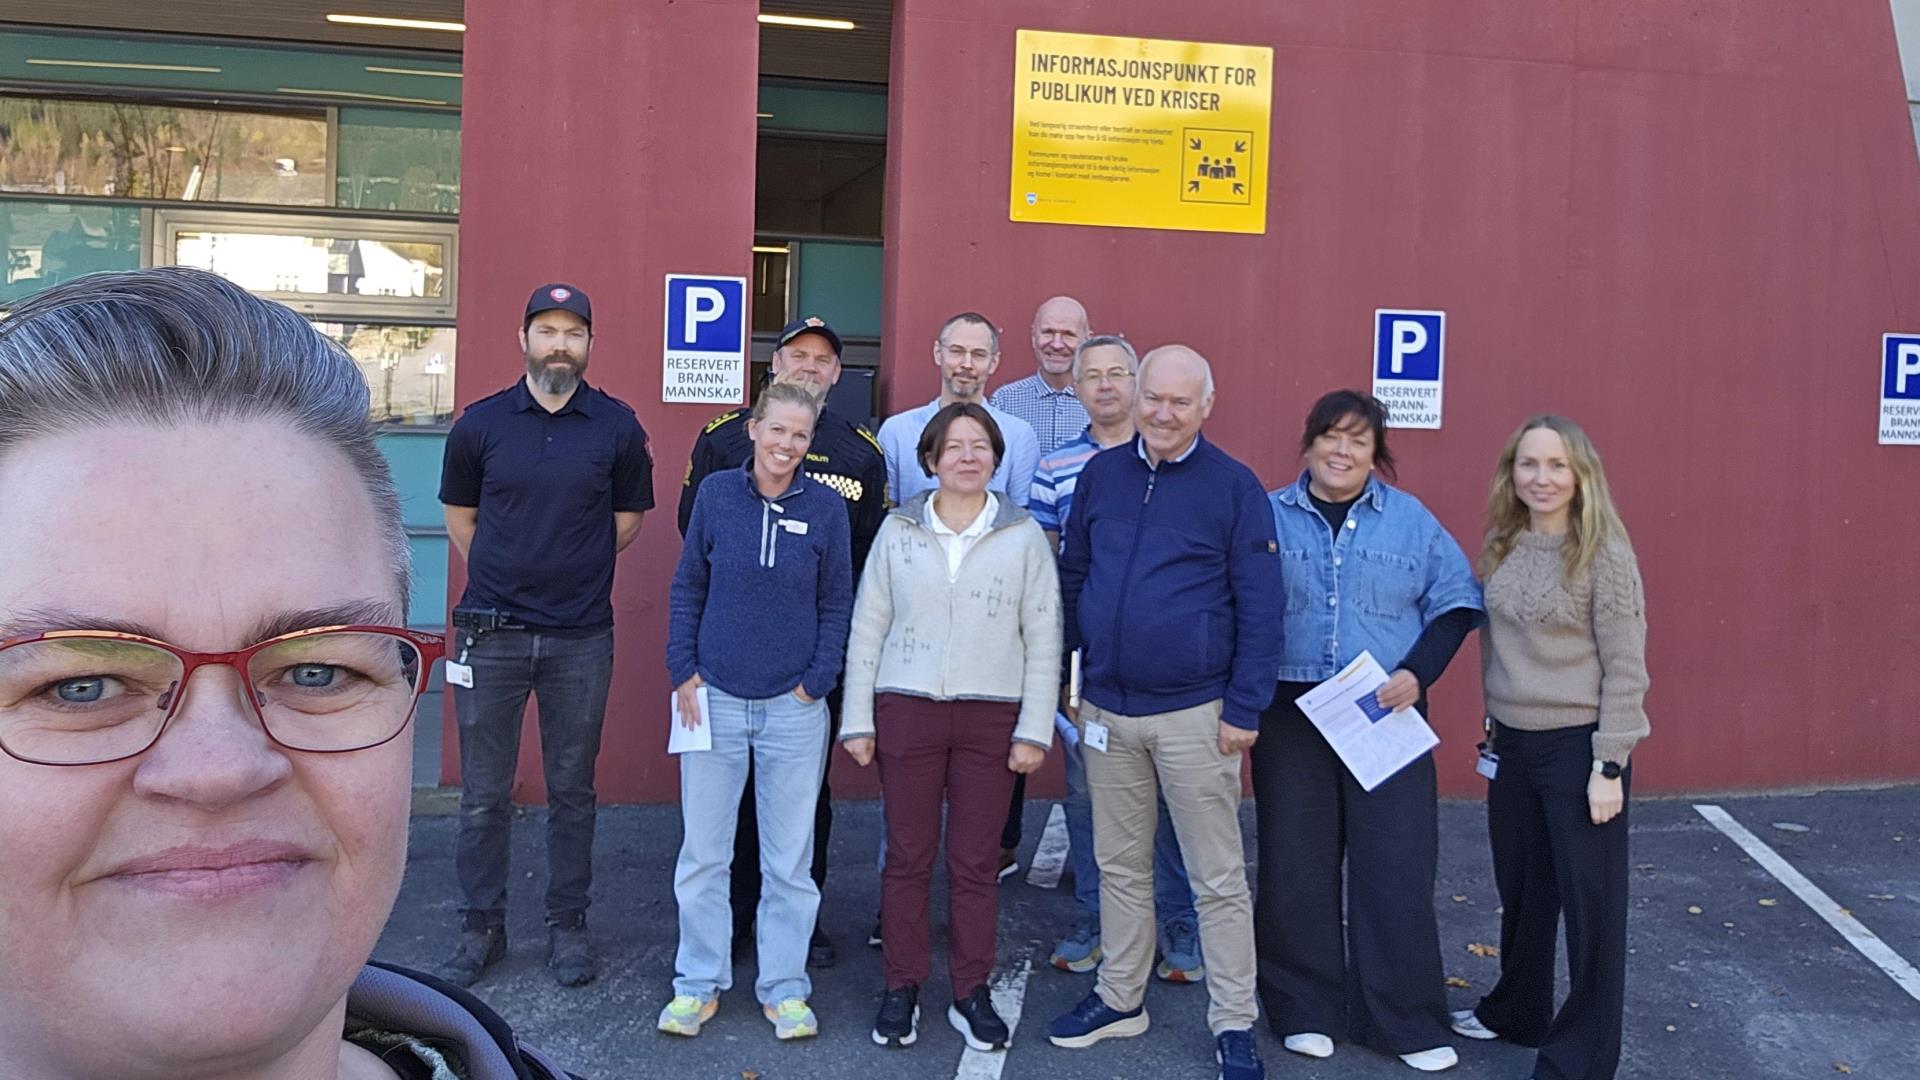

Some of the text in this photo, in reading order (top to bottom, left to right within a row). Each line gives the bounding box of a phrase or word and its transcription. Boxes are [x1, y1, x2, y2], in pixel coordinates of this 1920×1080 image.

[1031, 53, 1256, 87] INFORMASJONSPUNKT FOR
[1030, 80, 1220, 111] PUBLIKUM VED KRISER
[684, 286, 726, 344] P
[1391, 320, 1428, 374] P
[667, 357, 741, 371] RESERVERT
[1896, 343, 1920, 394] P
[677, 371, 729, 385] BRANN-
[664, 385, 741, 399] MANNSKAP
[1375, 386, 1438, 398] RESERVERT
[1385, 412, 1438, 424] ANNSKAP
